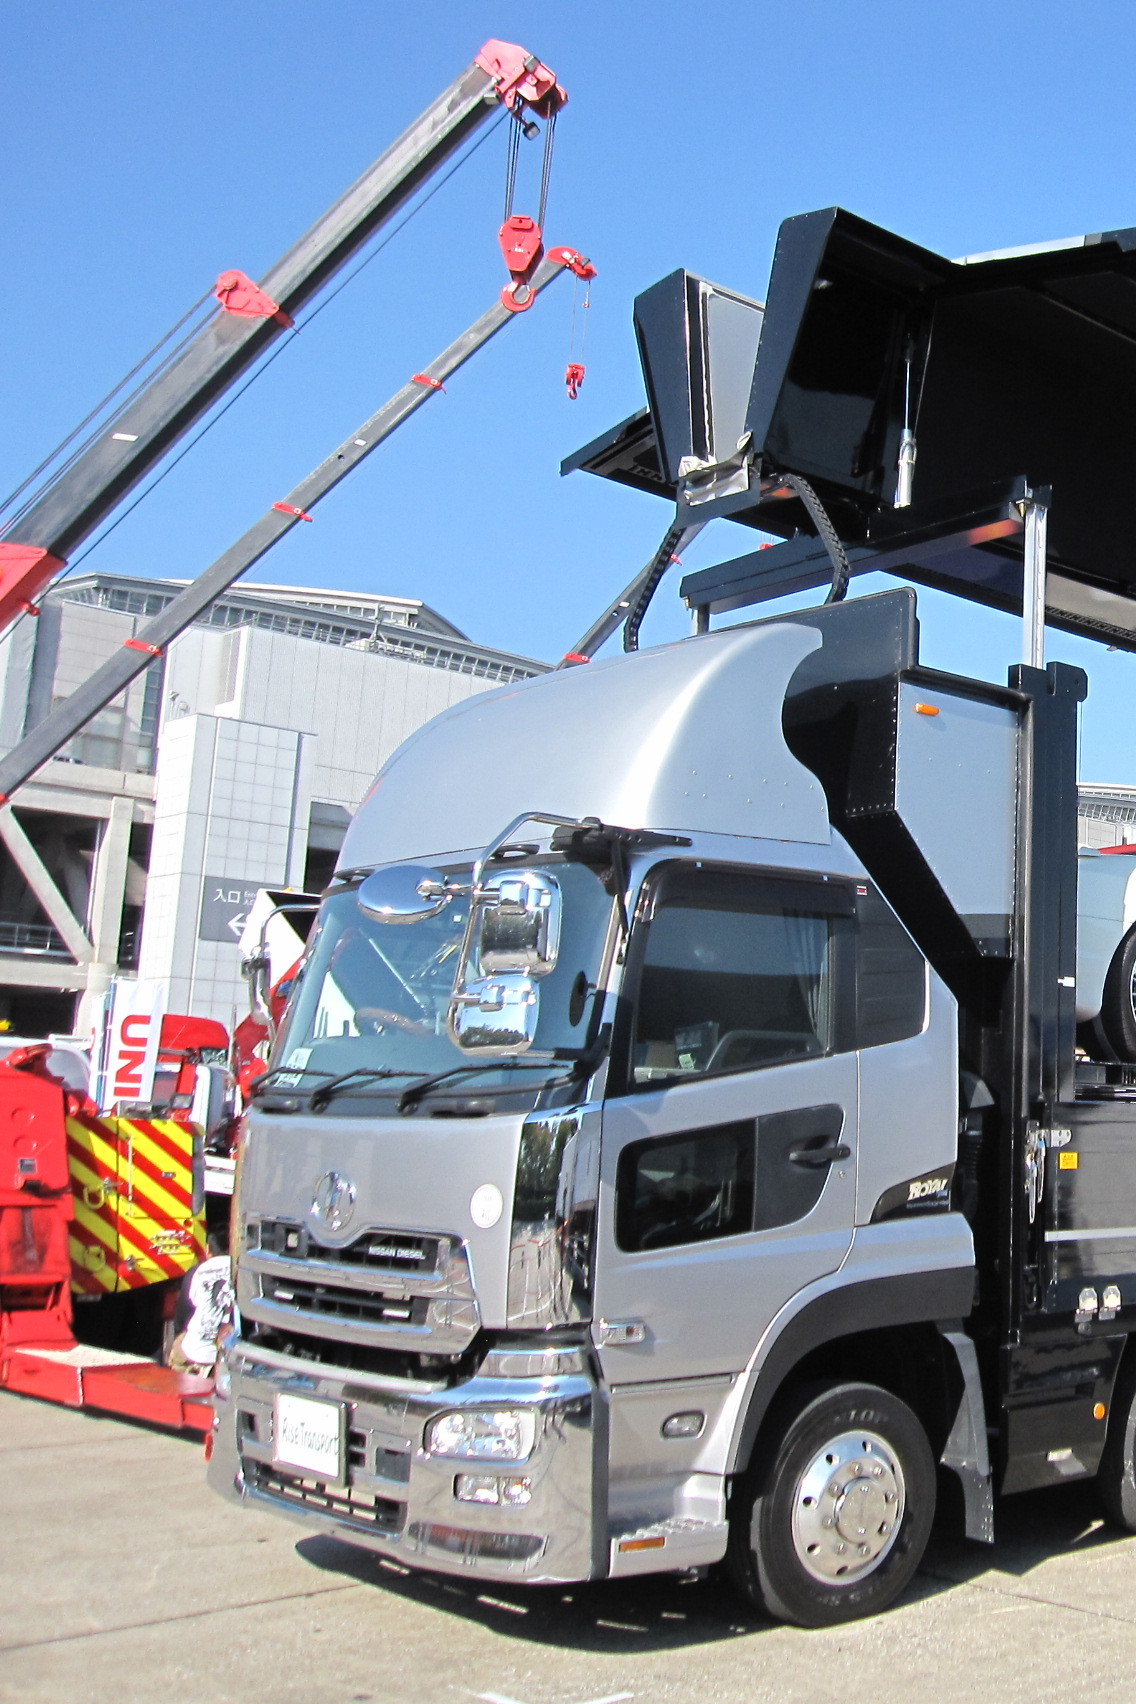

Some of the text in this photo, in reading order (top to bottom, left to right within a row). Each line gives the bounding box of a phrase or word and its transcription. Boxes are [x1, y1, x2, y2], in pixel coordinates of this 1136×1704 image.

[213, 888, 241, 904] 入口
[113, 1014, 152, 1098] UNI
[368, 1245, 427, 1260] NISSAN DIESEL
